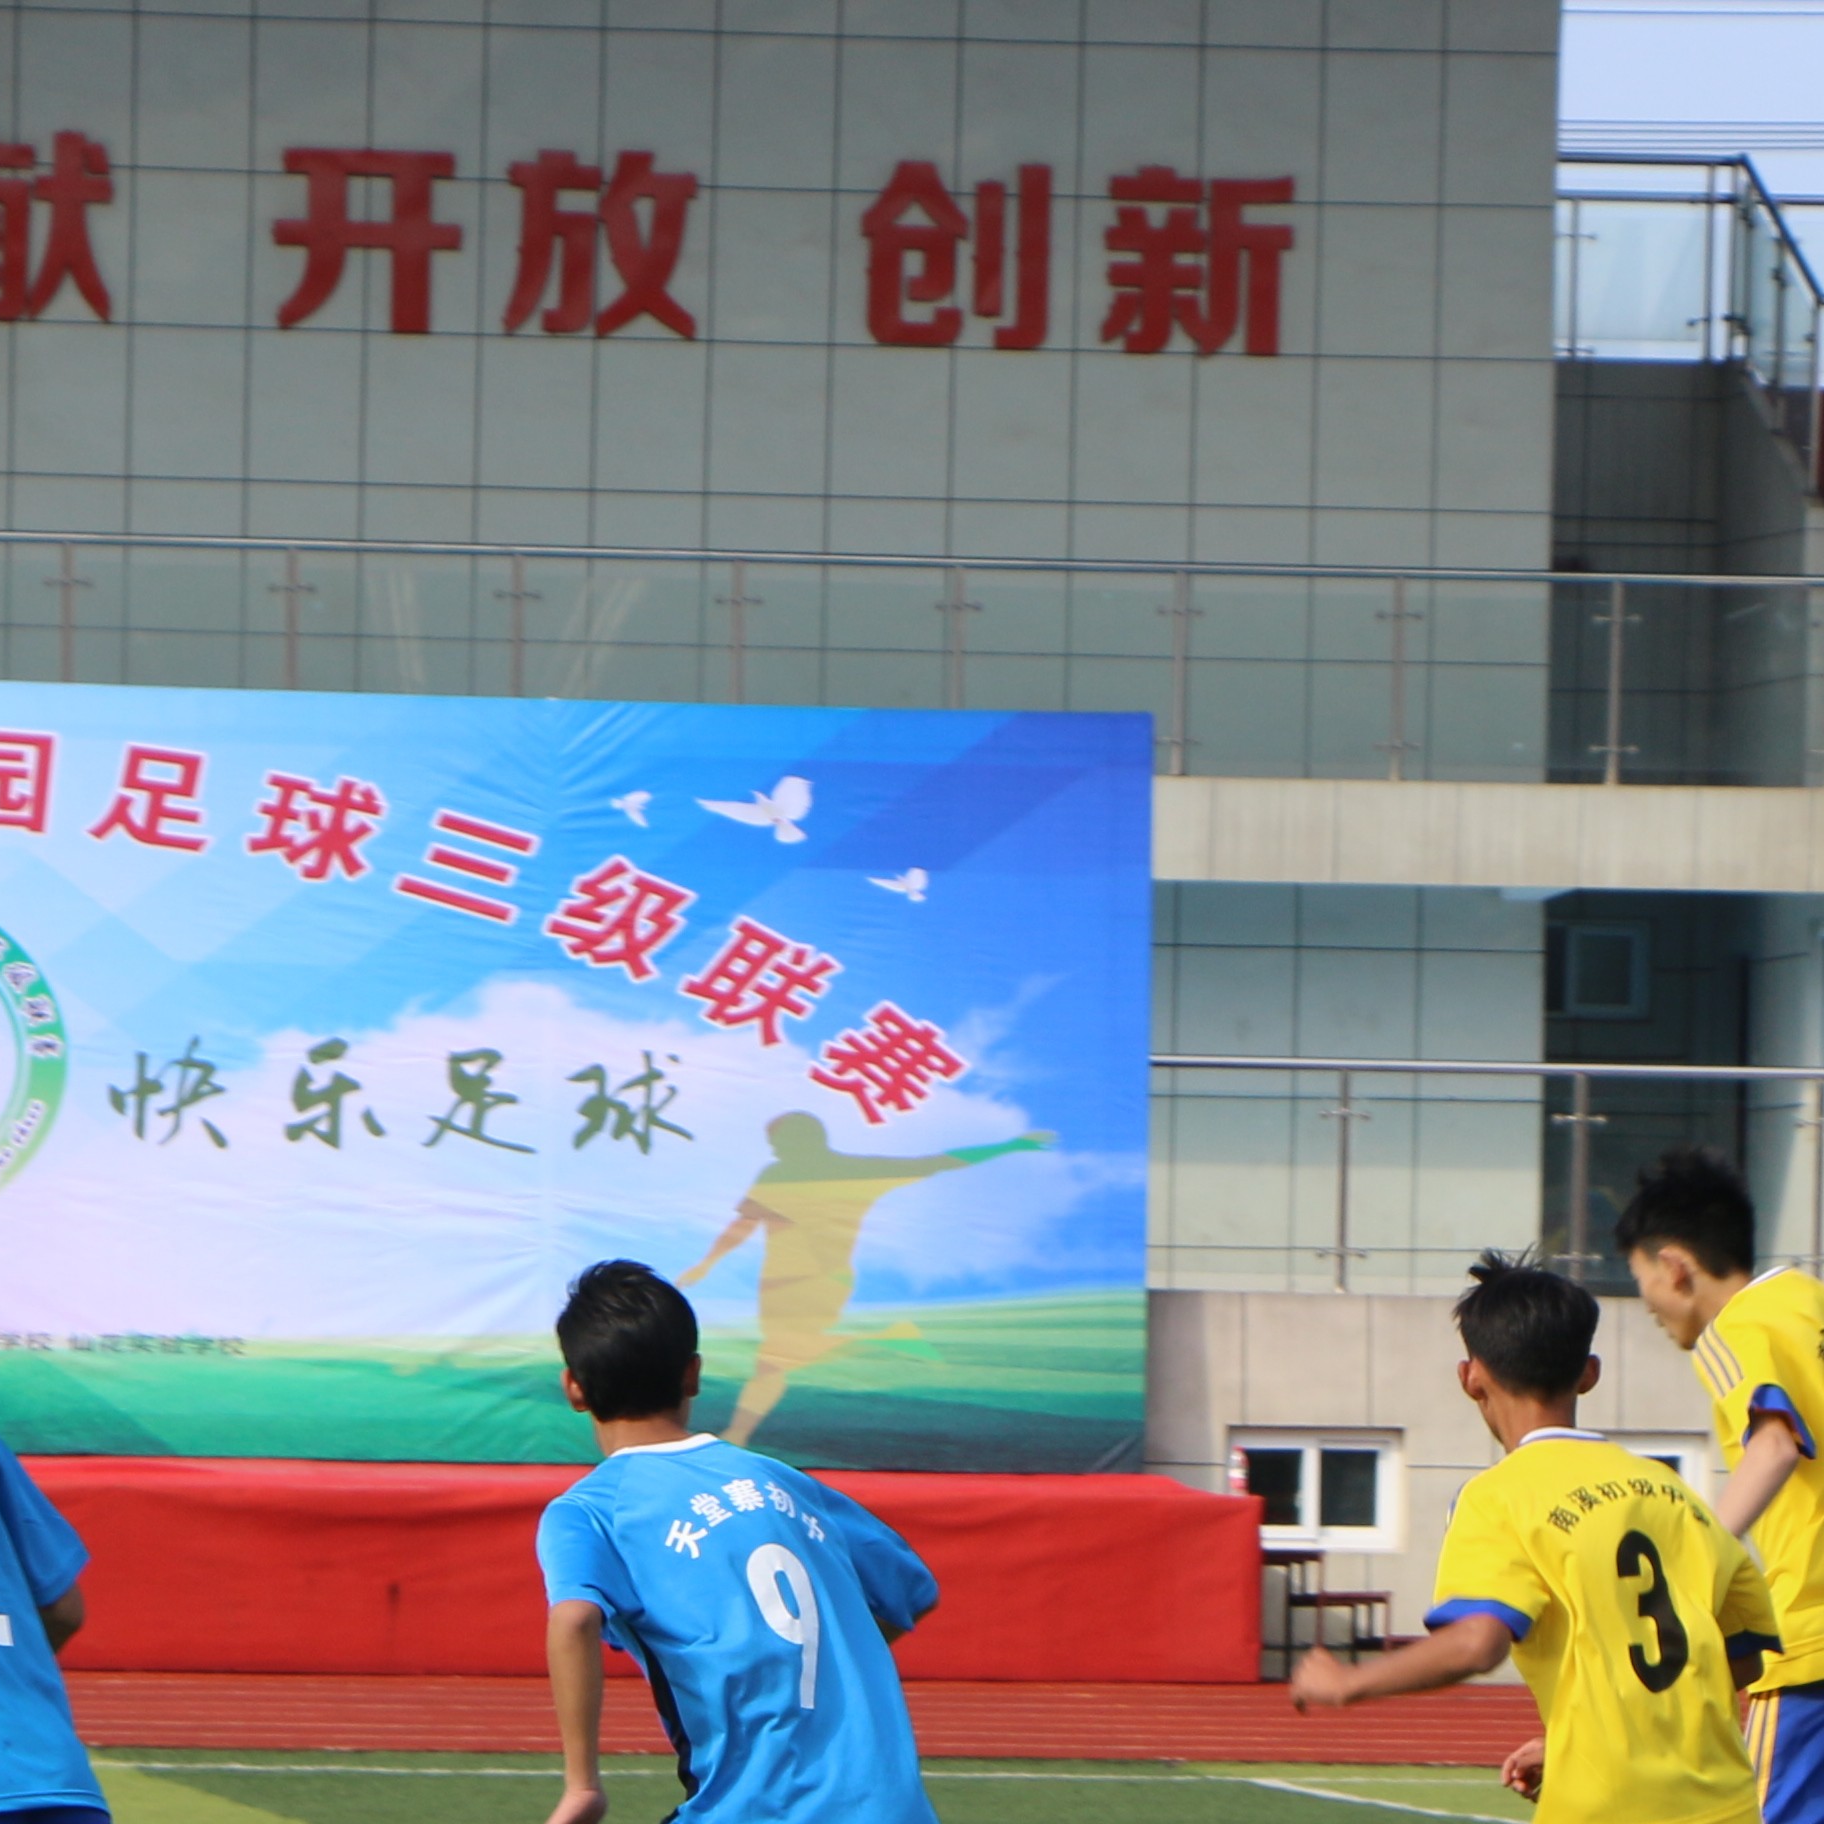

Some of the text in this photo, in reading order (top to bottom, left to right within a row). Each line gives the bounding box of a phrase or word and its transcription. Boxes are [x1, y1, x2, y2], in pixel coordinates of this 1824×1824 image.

[273, 148, 697, 339] 开放
[861, 160, 1295, 357] 创新
[107, 1035, 694, 1155] 快乐足球
[664, 1477, 826, 1561] 天堂寨初中
[745, 1542, 820, 1711] 9
[1616, 1529, 1689, 1694] 3
